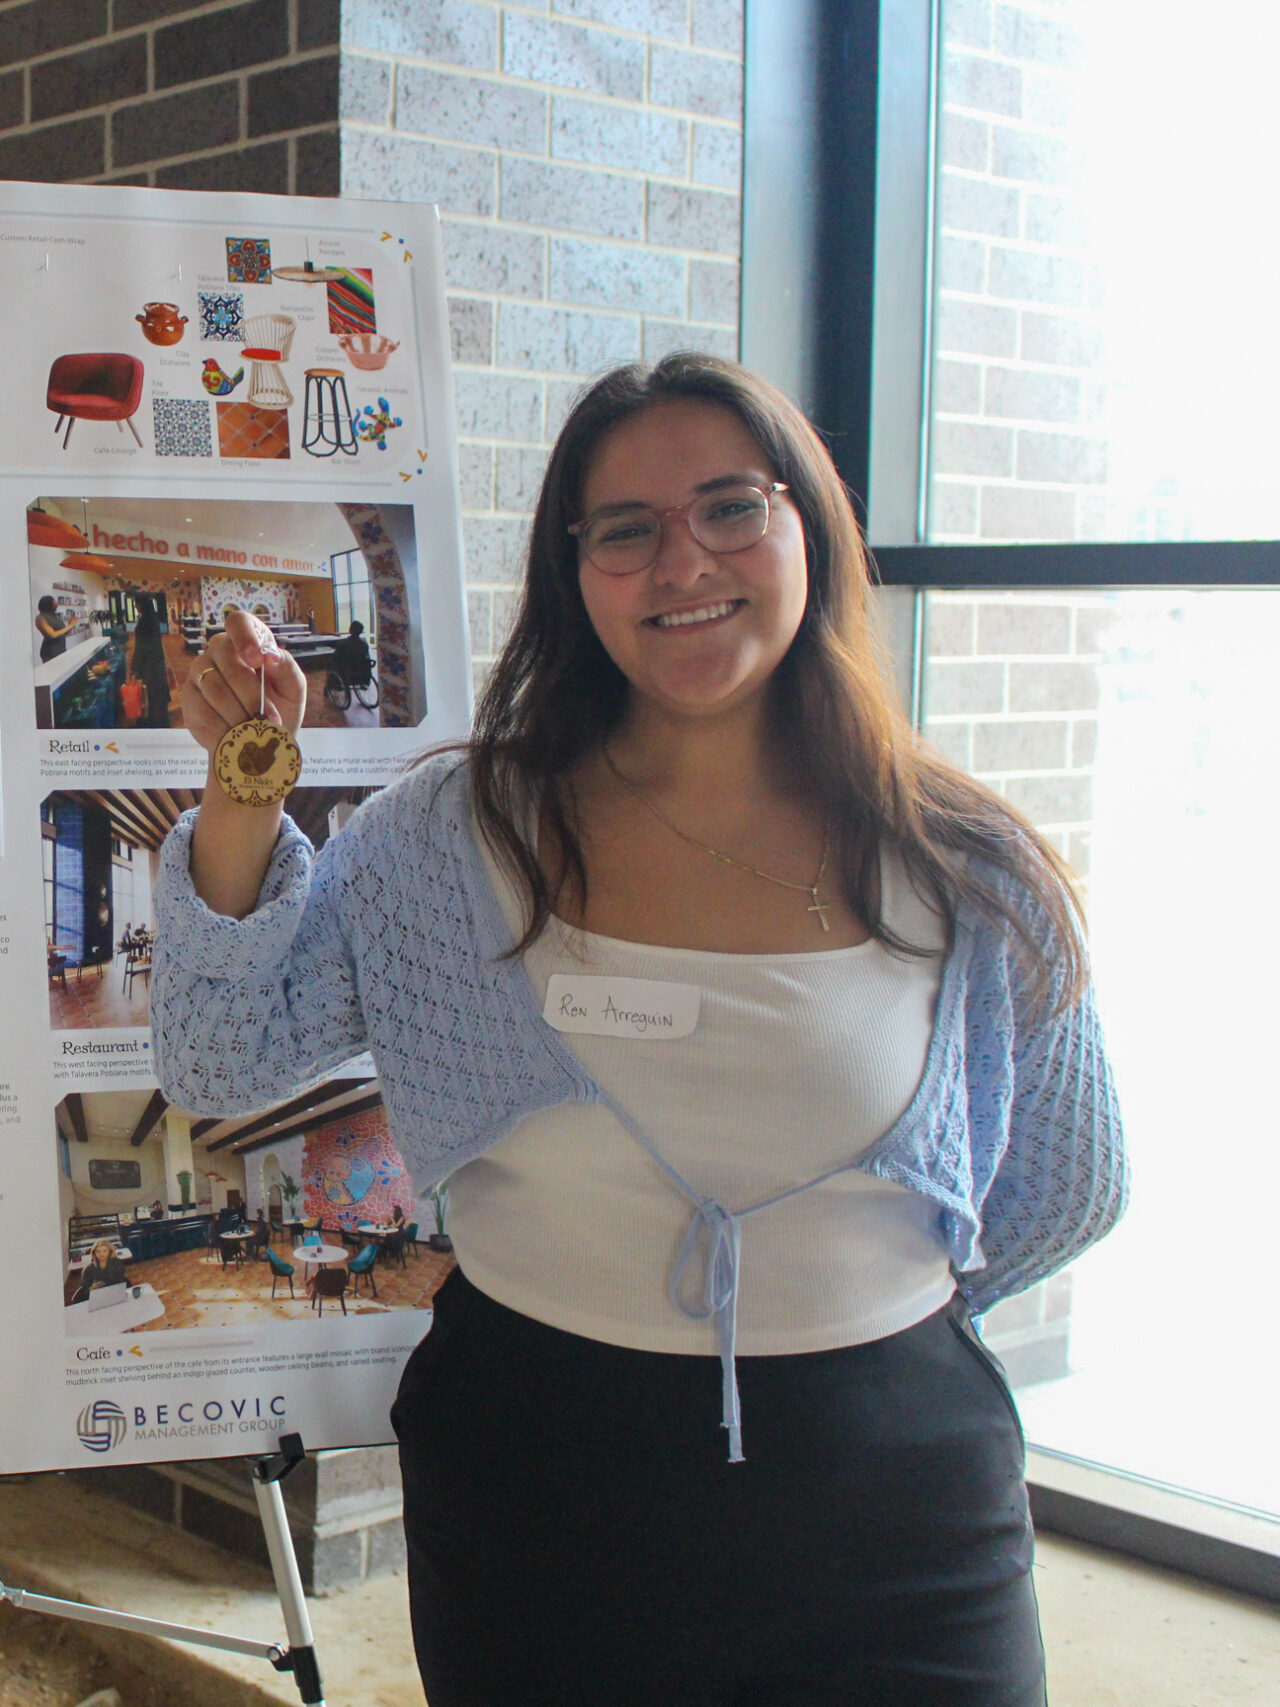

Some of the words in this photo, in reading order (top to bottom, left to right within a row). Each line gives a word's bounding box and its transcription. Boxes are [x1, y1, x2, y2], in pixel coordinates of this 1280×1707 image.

[92, 524, 169, 554] hecho
[176, 541, 190, 556] a
[196, 545, 247, 565] mano
[252, 553, 278, 568] con
[282, 558, 316, 572] amor
[49, 739, 90, 753] Retail
[560, 994, 587, 1017] Ren
[602, 995, 672, 1032] Arreguin
[62, 1038, 138, 1055] Restaurant
[76, 1346, 111, 1360] Cafe
[134, 1396, 286, 1426] BECOVIC
[135, 1422, 233, 1440] MANAGEMENT
[239, 1419, 285, 1433] GROUP
